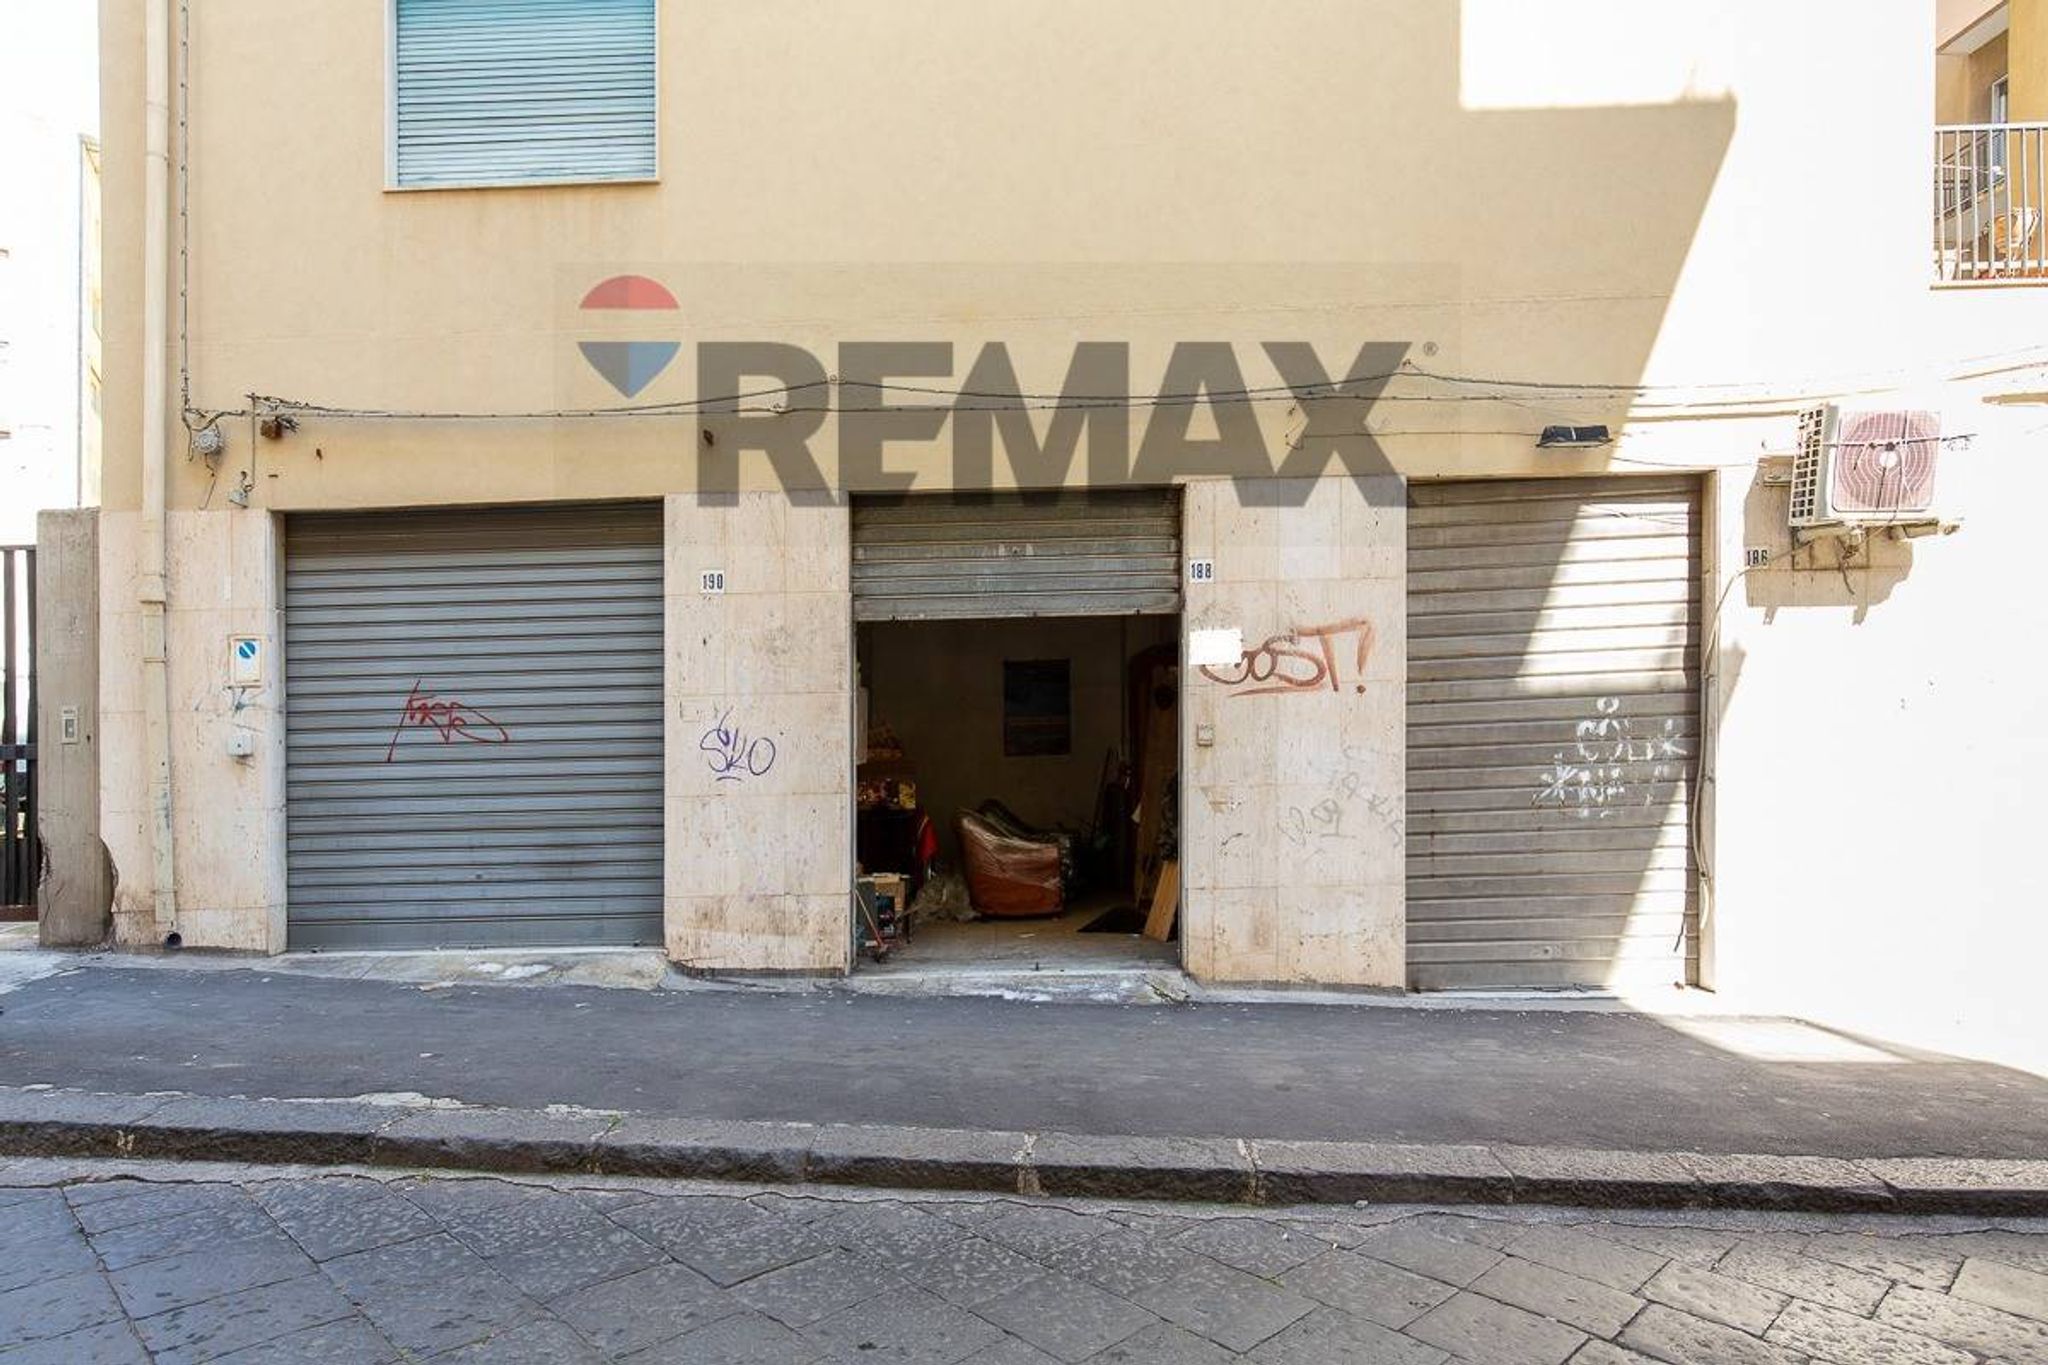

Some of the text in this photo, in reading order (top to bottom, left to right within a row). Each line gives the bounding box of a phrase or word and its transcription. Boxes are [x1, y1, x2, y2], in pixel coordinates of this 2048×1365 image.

[1746, 549, 1768, 566] 186
[1191, 562, 1212, 579] 188
[702, 573, 724, 590] 190
